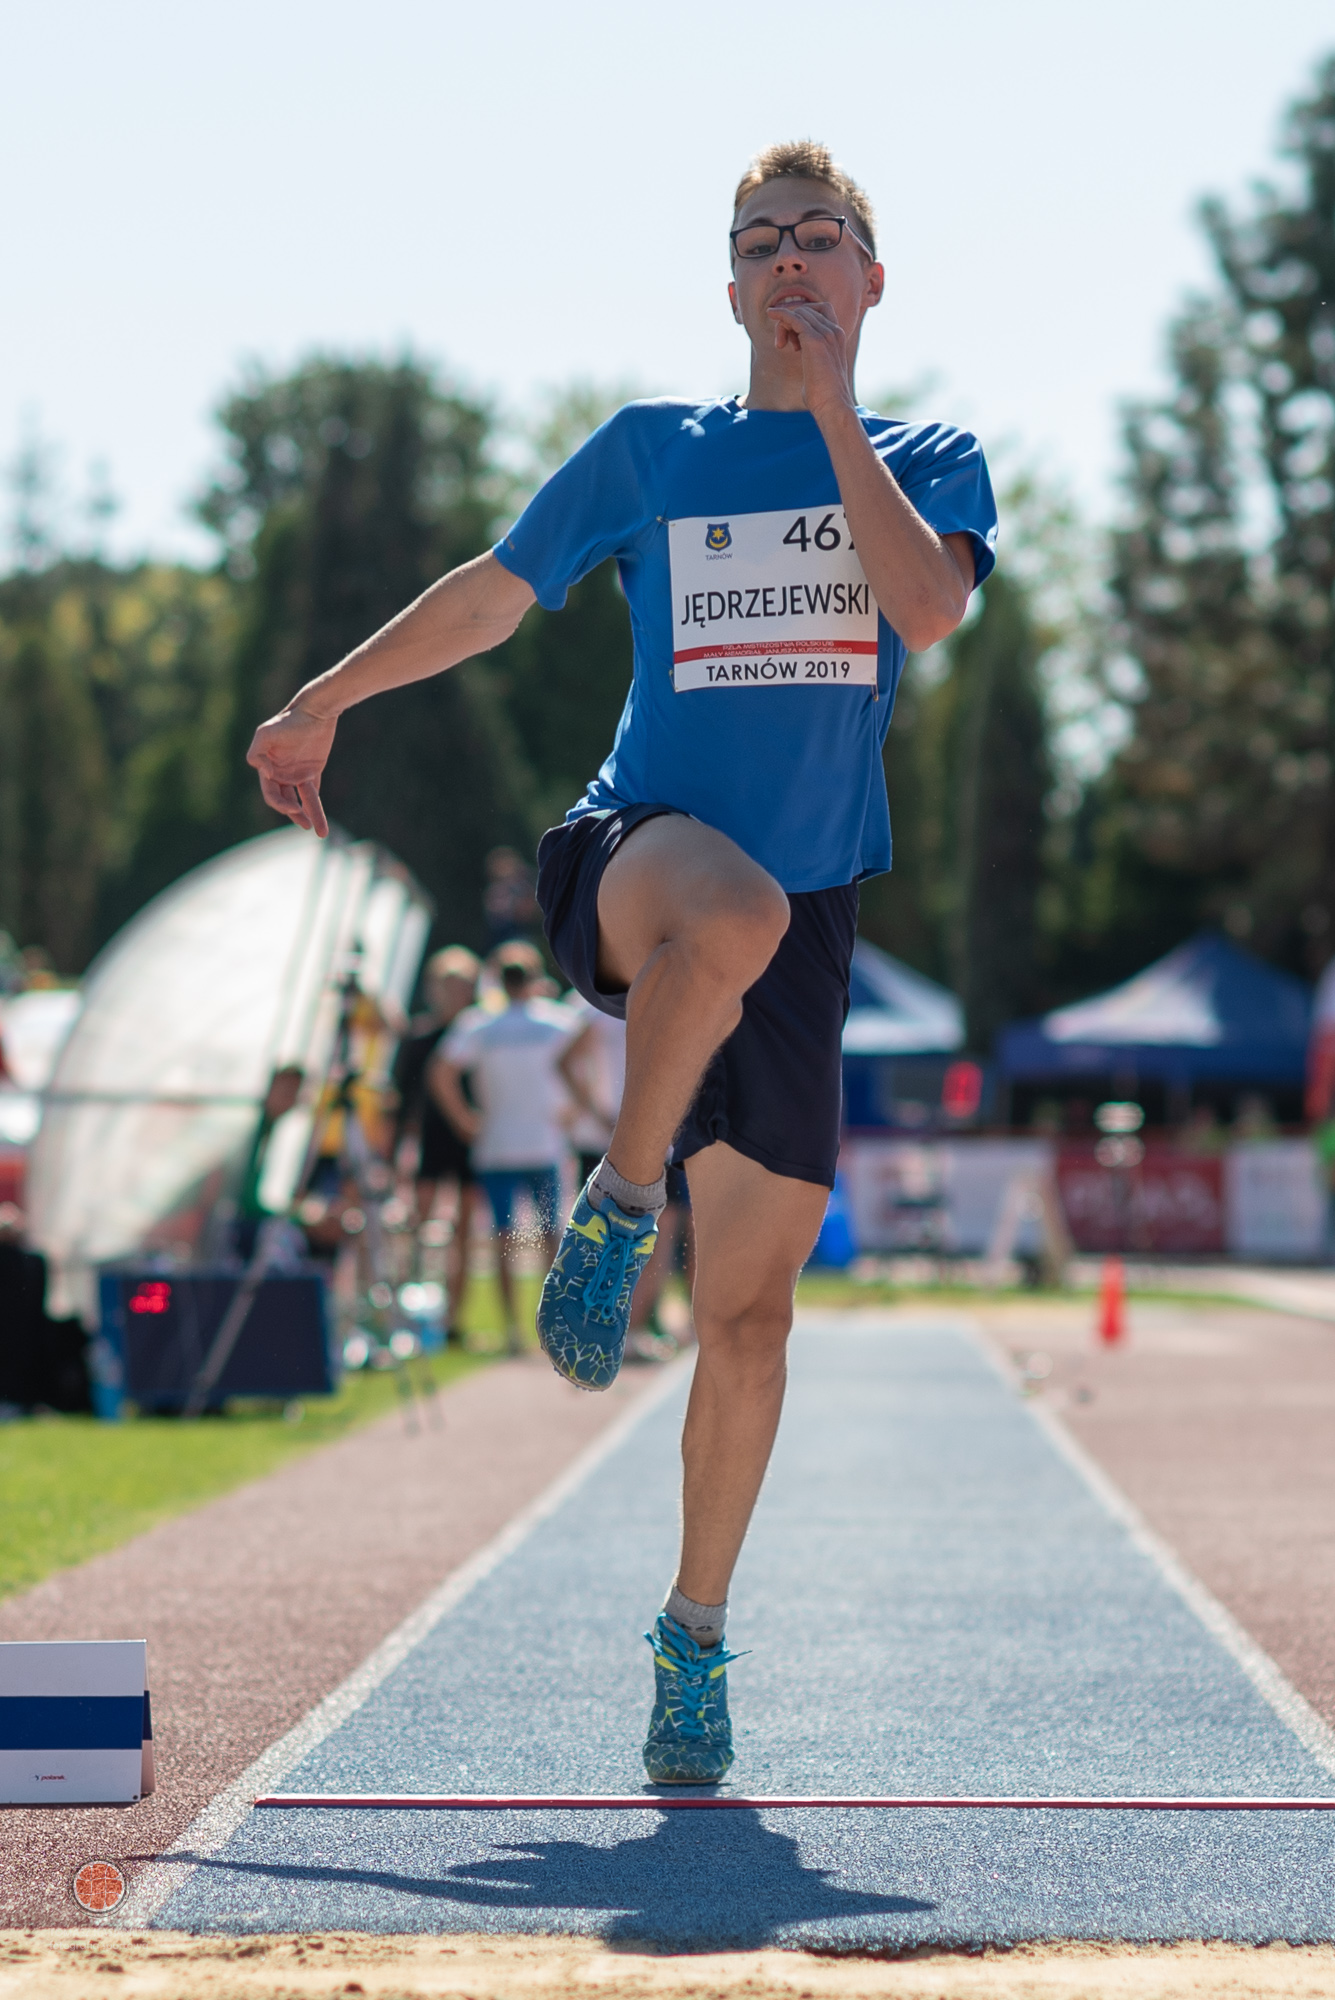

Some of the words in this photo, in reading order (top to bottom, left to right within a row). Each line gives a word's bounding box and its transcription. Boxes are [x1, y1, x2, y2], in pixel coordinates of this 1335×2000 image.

[782, 512, 856, 552] 46
[681, 583, 870, 628] JĘDRZEJEWSKI
[706, 657, 798, 682] TARNÓW
[804, 661, 851, 679] 2019
